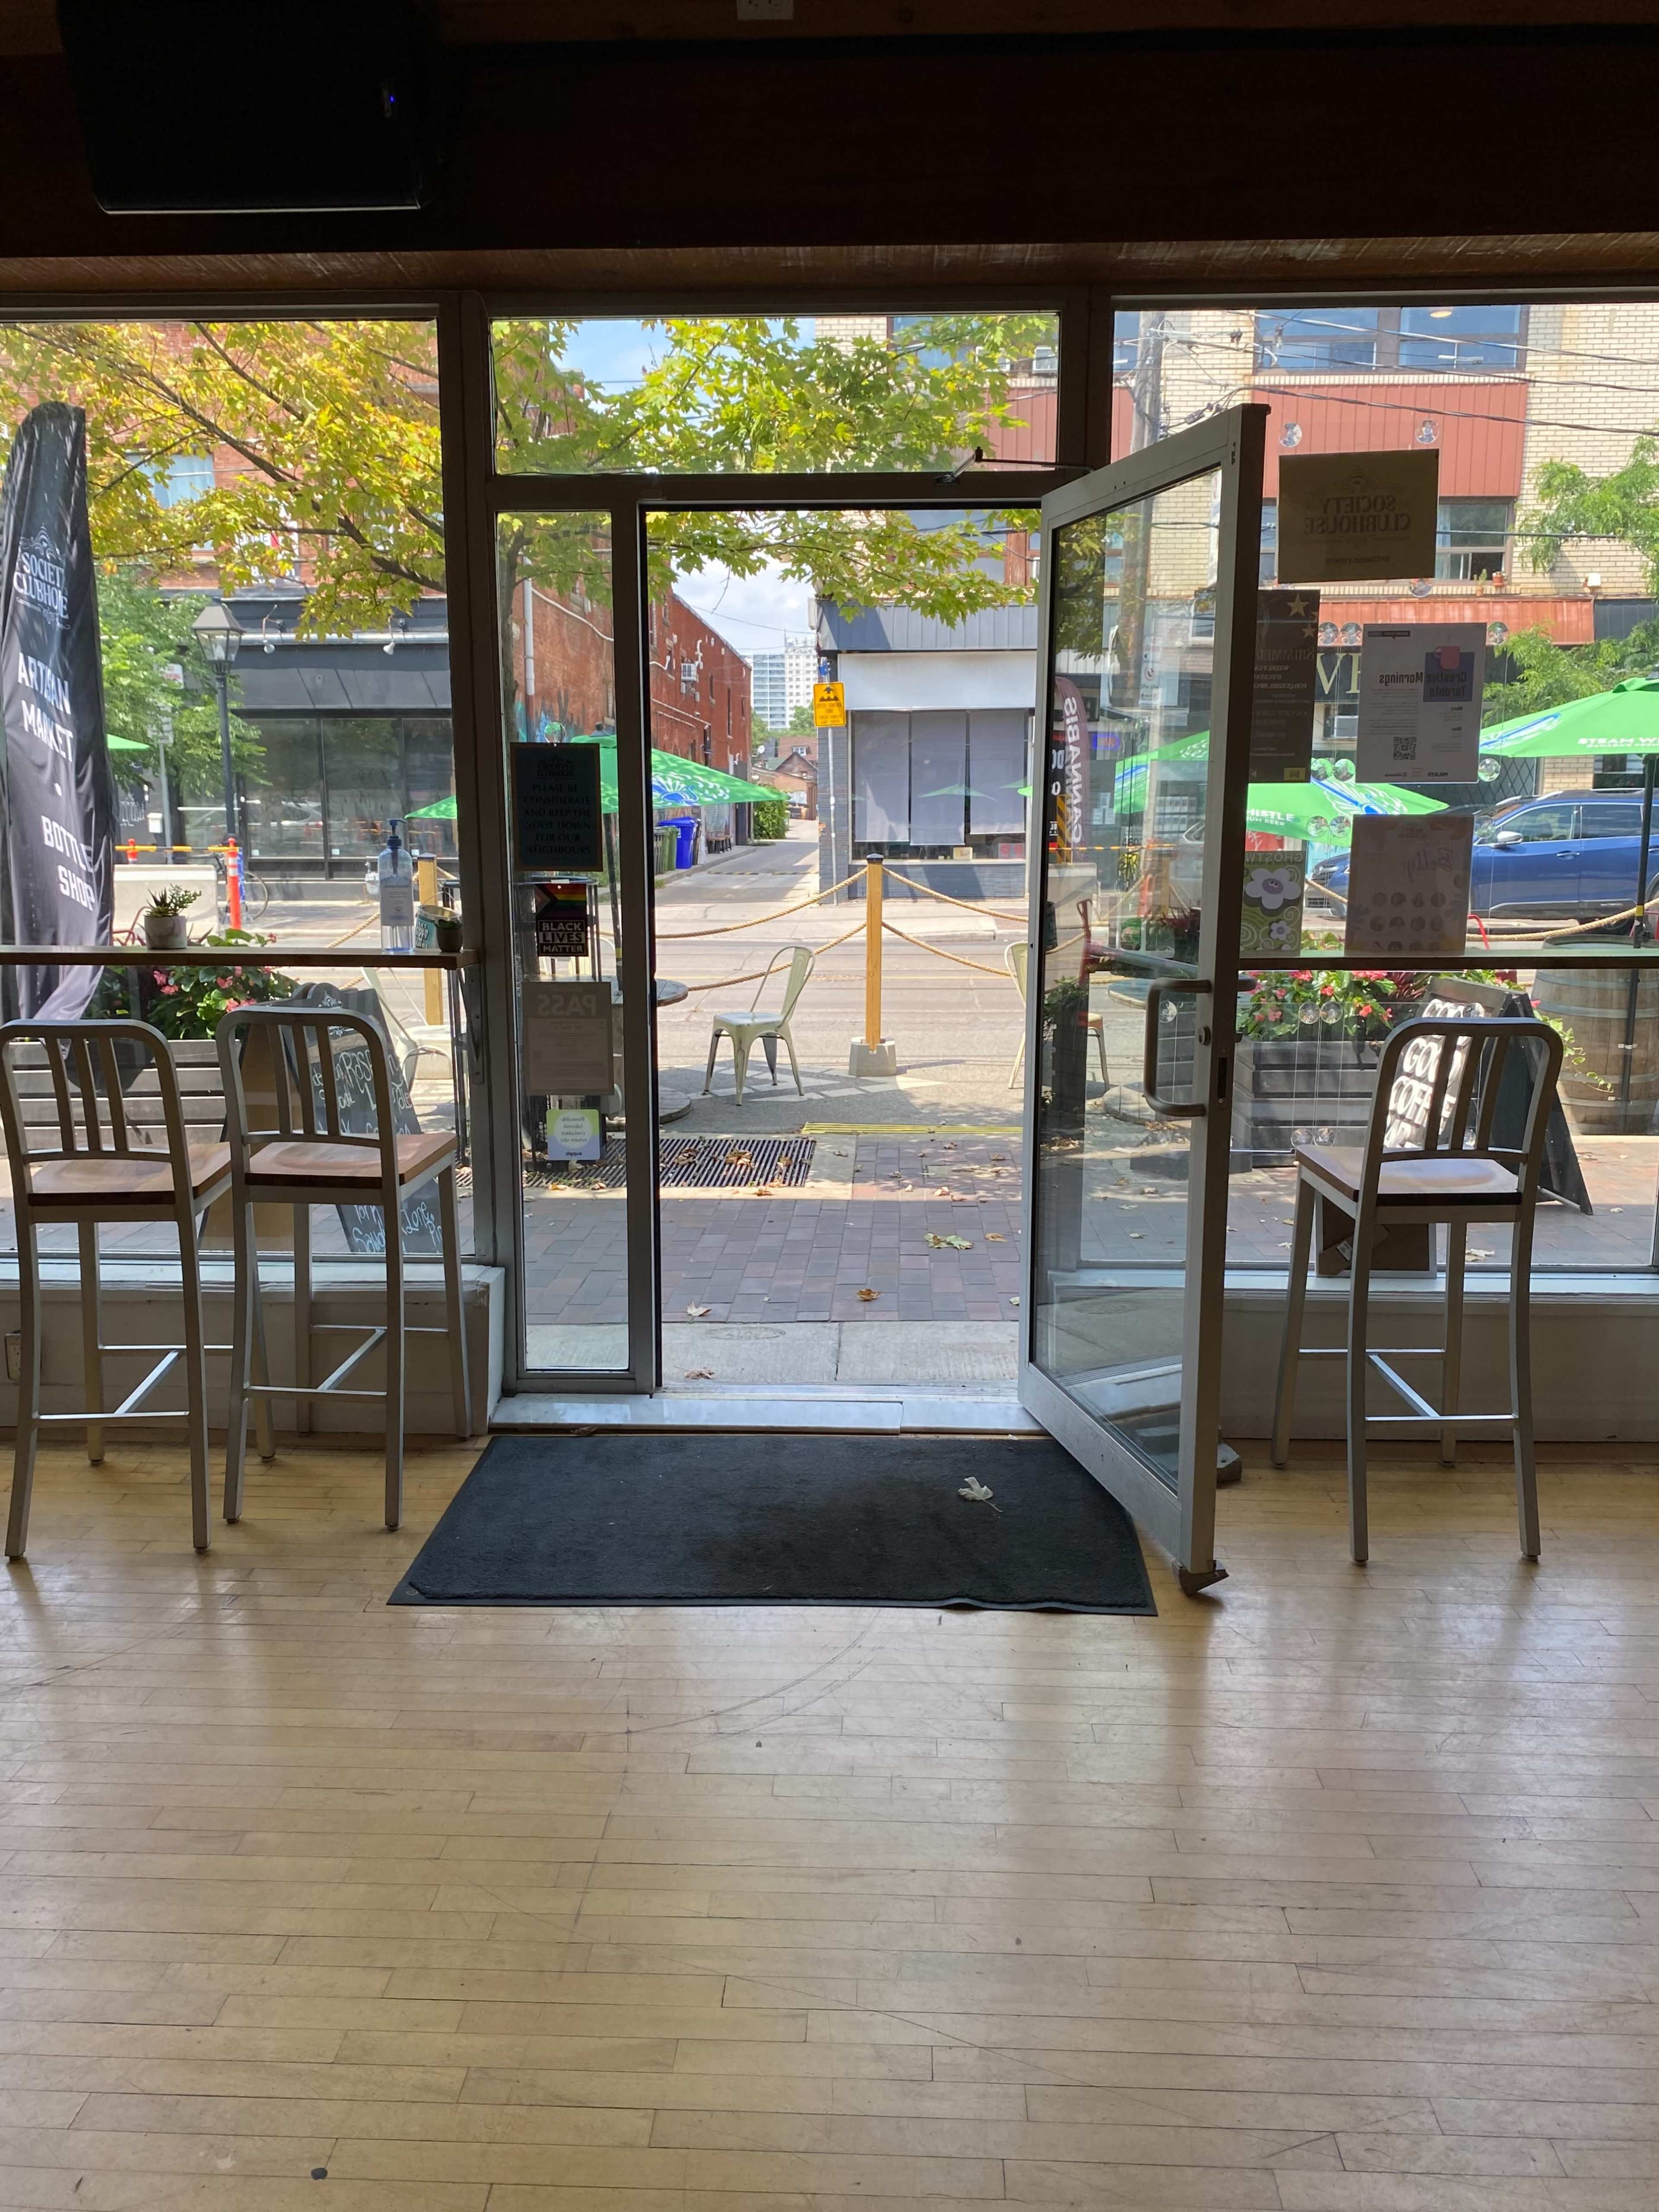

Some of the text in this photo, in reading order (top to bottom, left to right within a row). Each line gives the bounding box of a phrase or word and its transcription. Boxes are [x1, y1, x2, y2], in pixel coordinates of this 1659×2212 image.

[13, 571, 69, 619] CLUBHOE
[18, 652, 71, 715] ARTISAN
[22, 699, 73, 763] MARKET
[532, 783, 578, 792] PLEASE BE
[523, 796, 591, 804] CONSIDERATE
[524, 808, 546, 817] AND
[573, 809, 591, 817] THE
[557, 821, 591, 830] DOWN
[535, 833, 581, 842] FOR OUR
[41, 815, 94, 873] BOTTLE
[526, 845, 591, 854] NEIGHBOURS
[57, 864, 95, 911] SHOP
[542, 922, 582, 931] BLACK
[543, 932, 583, 943] LIVES
[543, 944, 583, 953] MATTER
[1389, 1075, 1456, 1136] COFFE
